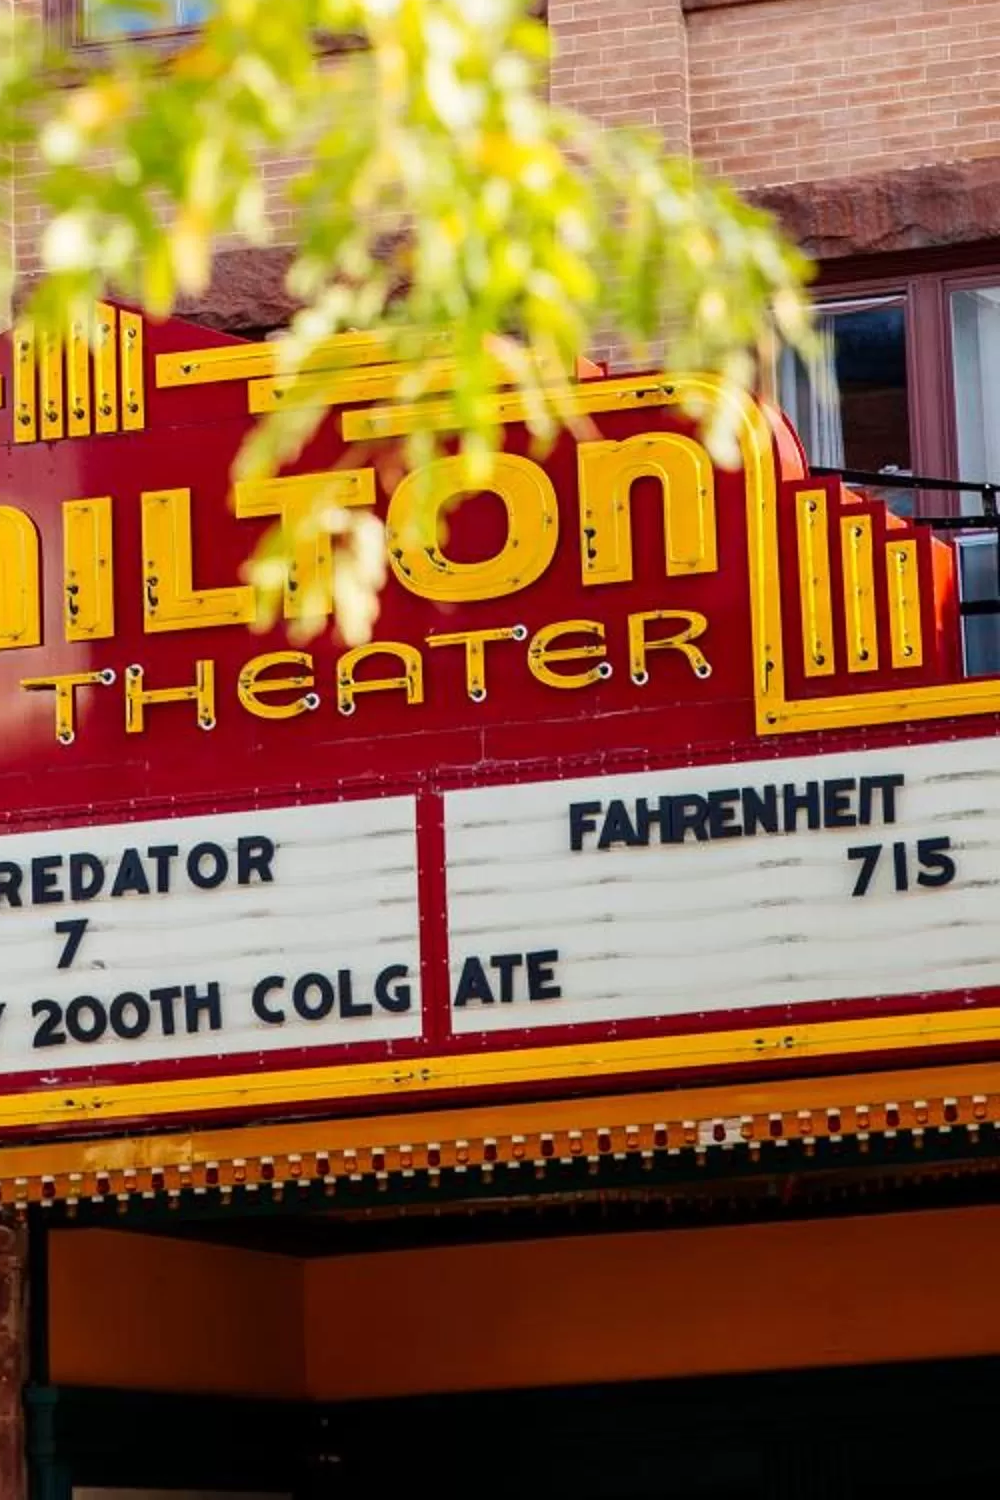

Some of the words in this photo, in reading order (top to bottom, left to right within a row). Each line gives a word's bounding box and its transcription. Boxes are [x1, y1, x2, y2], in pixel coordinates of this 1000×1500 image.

[19, 608, 713, 745] THEATER
[568, 772, 905, 851] FAHRENHEIT
[847, 835, 957, 897] 715
[55, 918, 89, 969] 7
[31, 981, 222, 1049] 200TH
[252, 963, 412, 1025] COLG
[453, 949, 562, 1007] ATE
